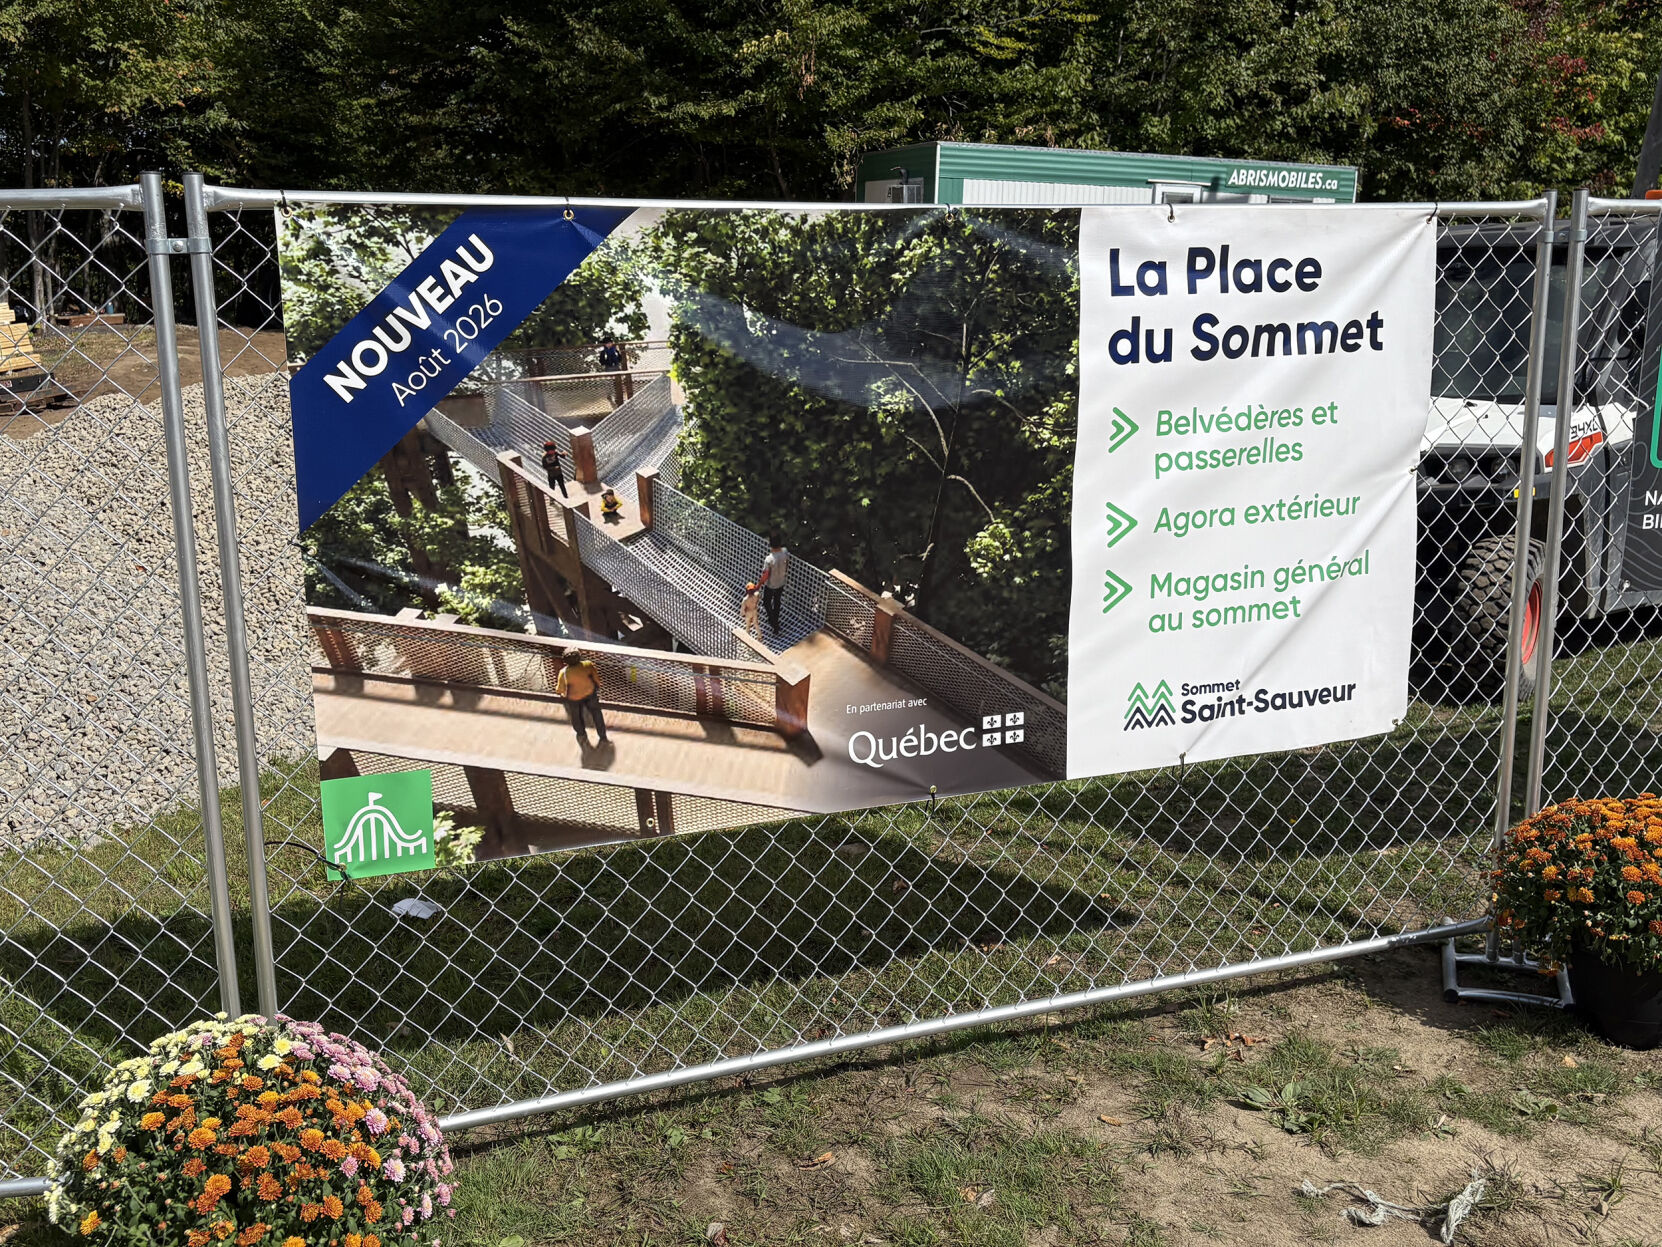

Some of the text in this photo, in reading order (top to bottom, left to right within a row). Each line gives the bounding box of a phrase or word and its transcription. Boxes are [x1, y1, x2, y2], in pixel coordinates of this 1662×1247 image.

[1228, 169, 1338, 190] ABRISMOBILES.ca
[1109, 244, 1322, 296] La Place
[322, 233, 495, 404] NOUVEAU
[1108, 310, 1384, 365] du Sommet
[391, 293, 503, 407] Août 2026
[1156, 402, 1338, 436] Belvédères et
[1154, 437, 1304, 479] passerelles
[1154, 493, 1360, 538] Agora extérieur
[1150, 550, 1370, 602] Magasin général
[1148, 596, 1301, 633] au sommet
[846, 697, 927, 716] En partenariat avec
[1180, 681, 1356, 723] Saint-Sauveur
[1181, 679, 1241, 697] Sommet
[849, 724, 976, 768] Québec
